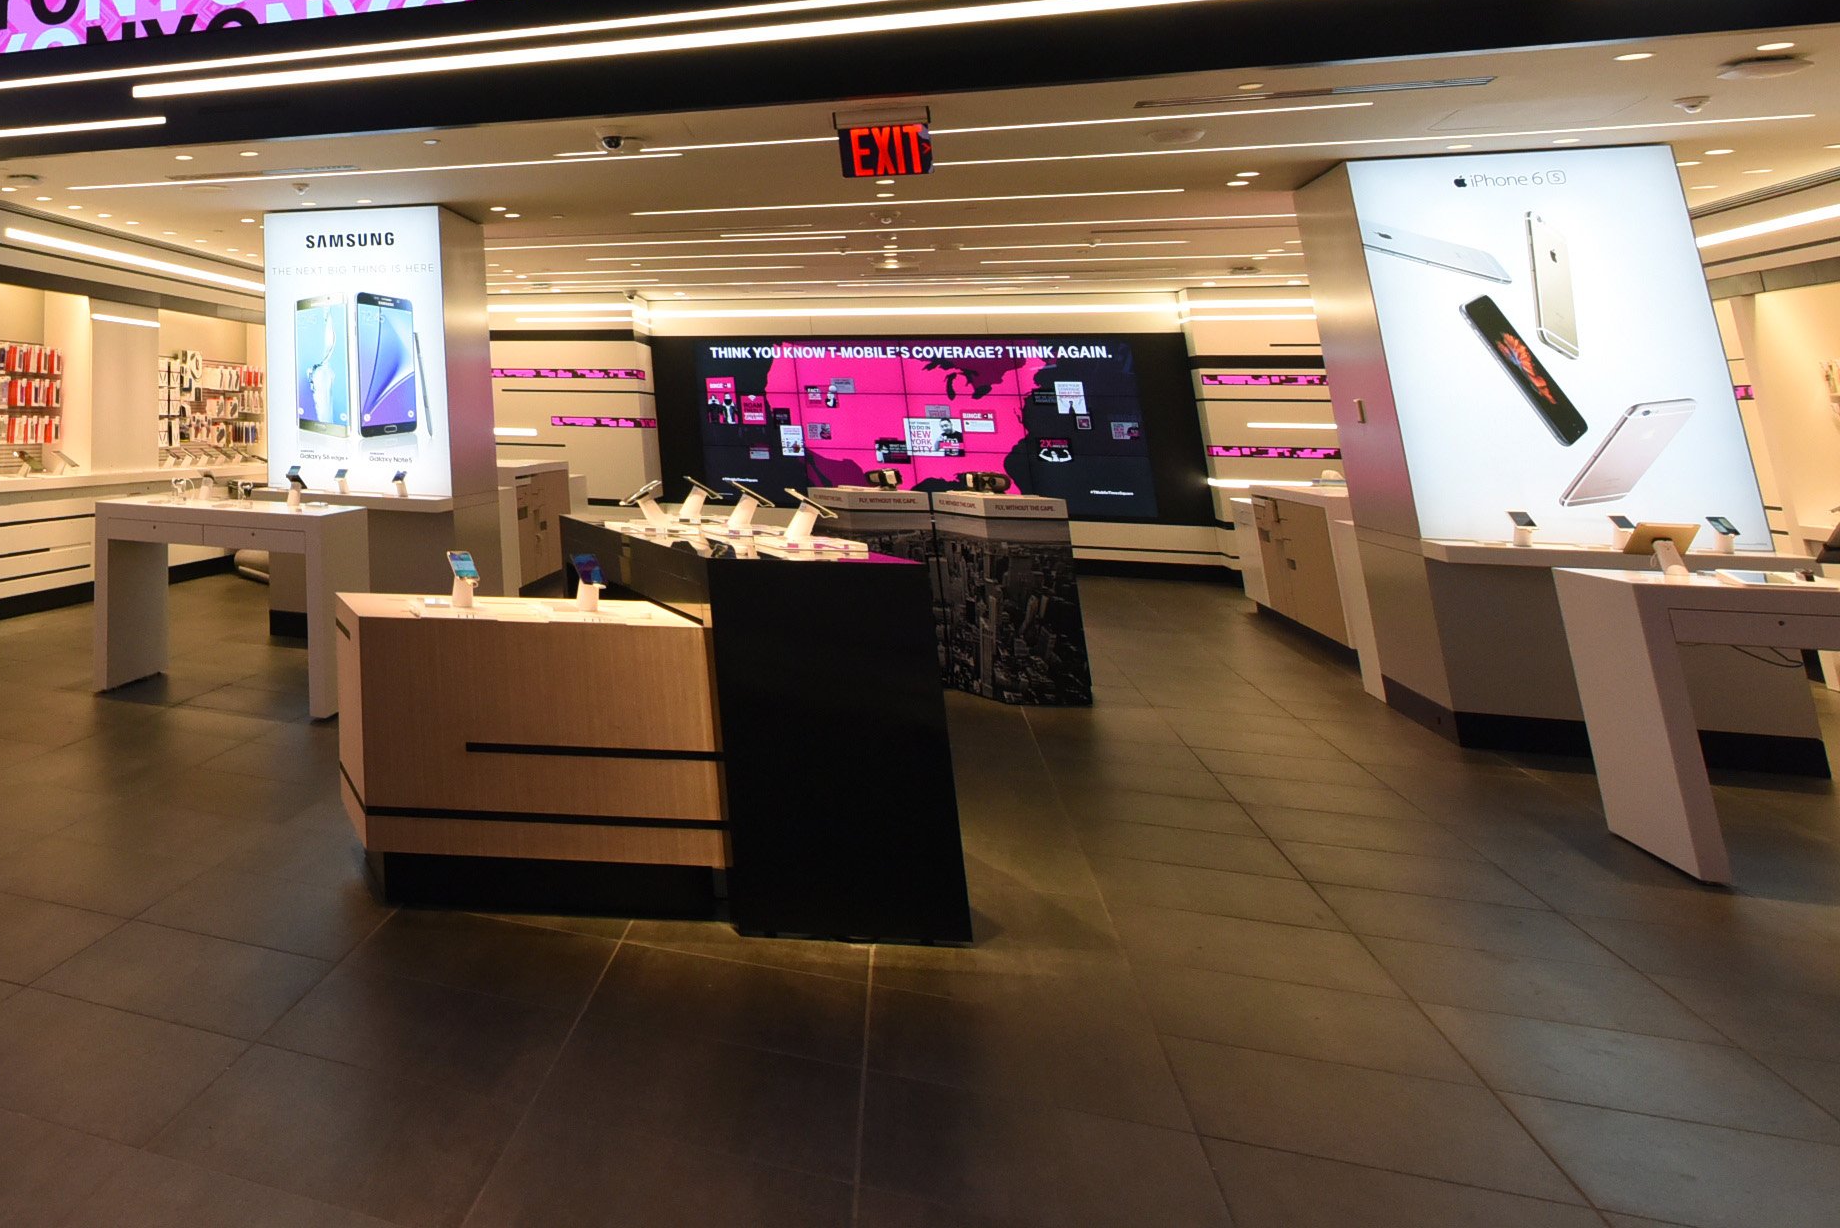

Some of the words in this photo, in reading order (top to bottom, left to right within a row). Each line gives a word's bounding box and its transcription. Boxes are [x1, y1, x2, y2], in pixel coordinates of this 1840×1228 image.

[850, 124, 922, 176] EXIT
[1470, 174, 1527, 187] iPhone
[1532, 172, 1543, 185] 6
[306, 232, 395, 249] SAMSUNG
[272, 267, 292, 276] THE
[296, 266, 322, 275] NEXT
[328, 266, 347, 275] BIG
[352, 264, 386, 274] THING
[392, 264, 401, 273] IS
[405, 263, 434, 273] HERE
[710, 346, 751, 359] THINK
[753, 346, 782, 359] YOU
[783, 346, 826, 359] KNOW
[828, 346, 910, 359] T-MOBILE'S
[912, 346, 1003, 359] COVERAGE?
[1006, 346, 1054, 359] THINK
[1057, 346, 1112, 359] AGAIN.
